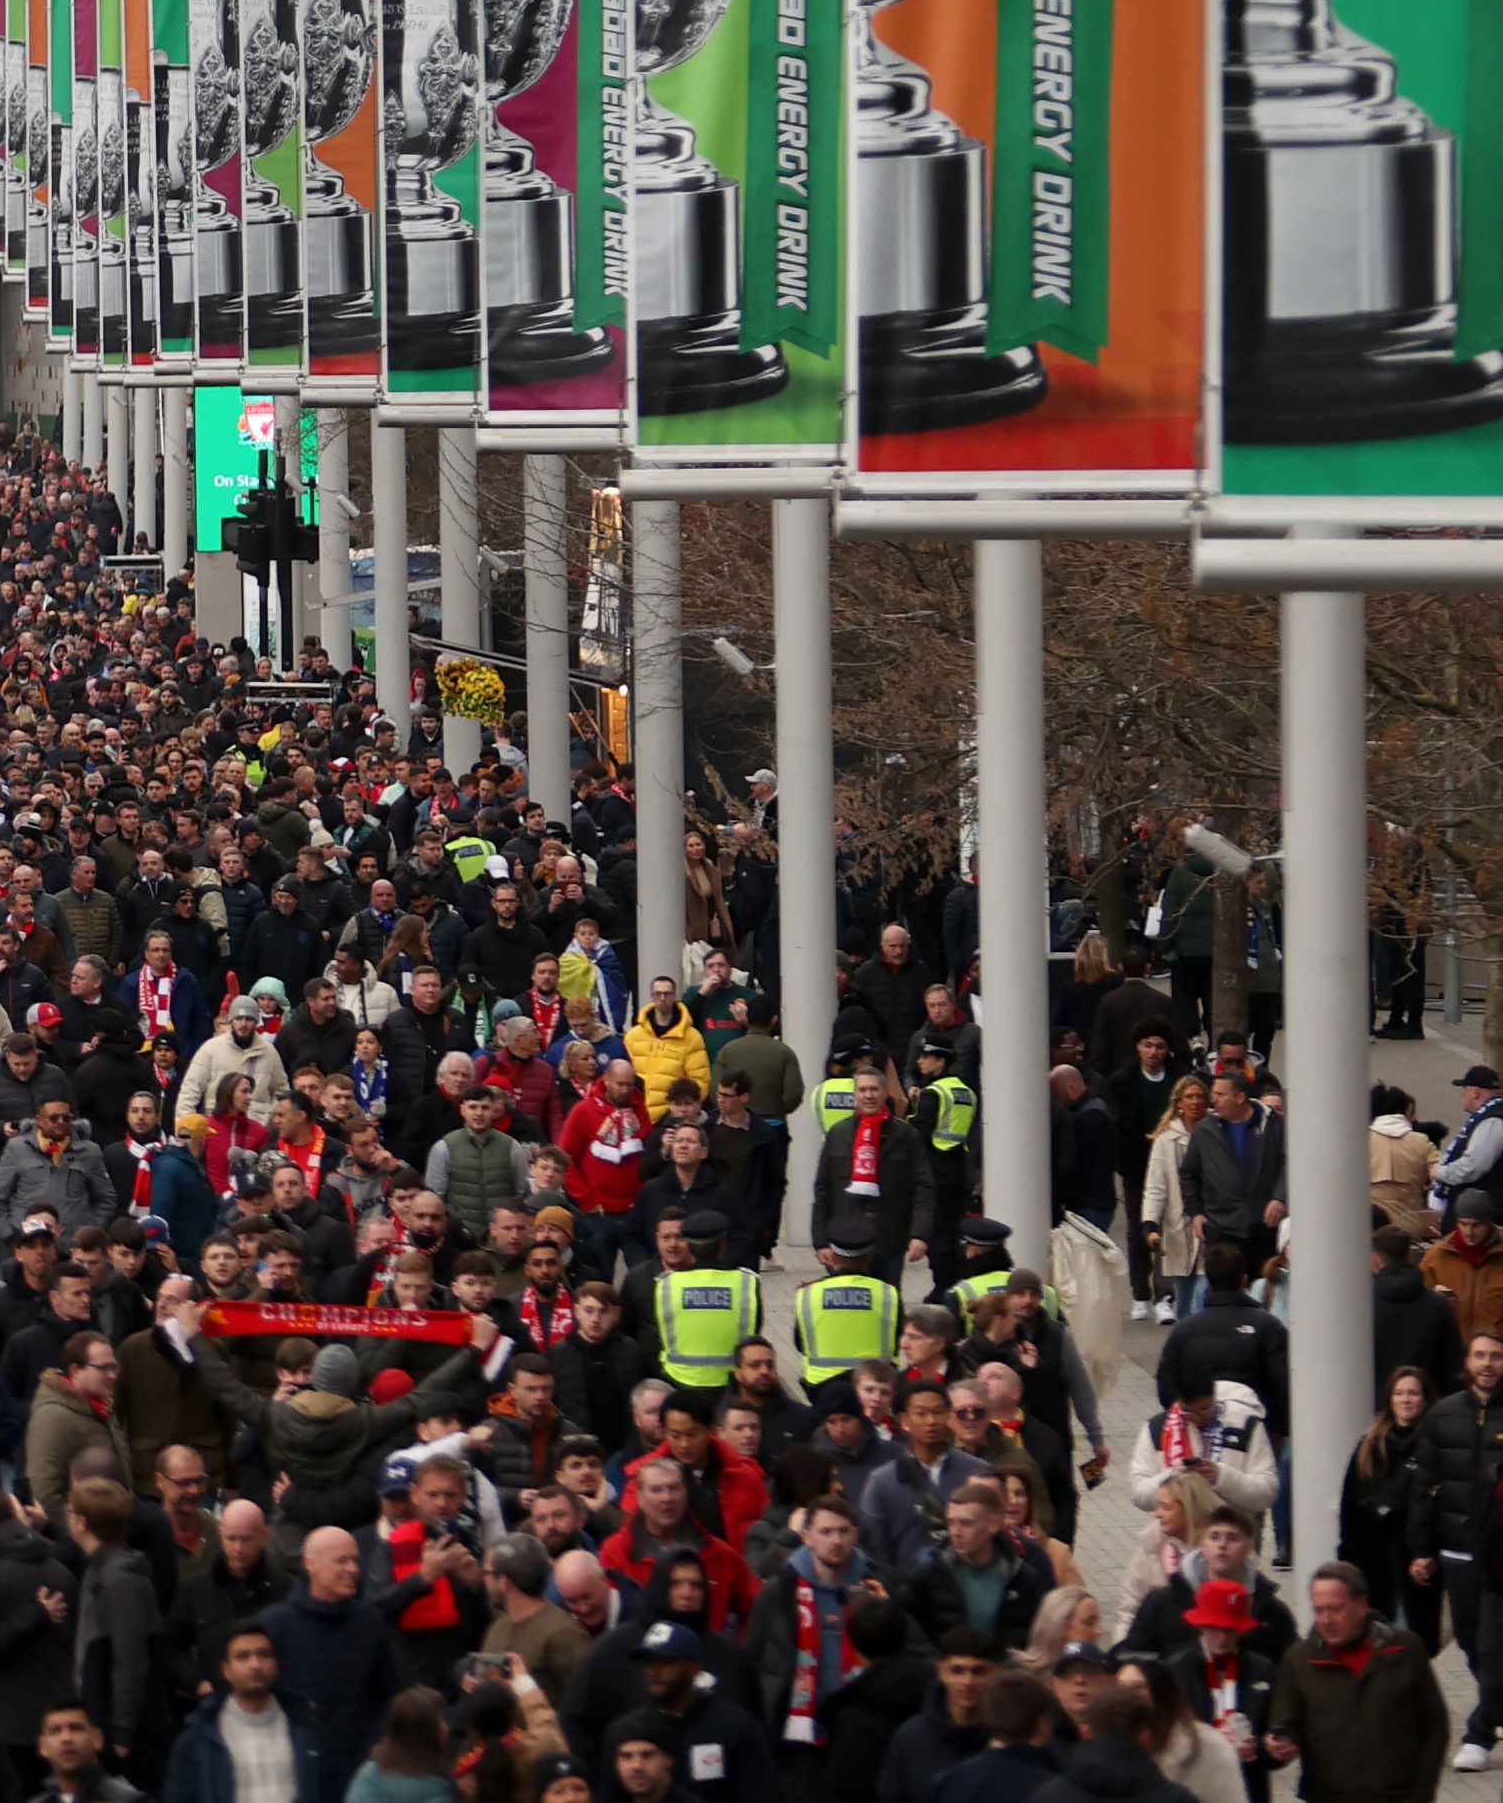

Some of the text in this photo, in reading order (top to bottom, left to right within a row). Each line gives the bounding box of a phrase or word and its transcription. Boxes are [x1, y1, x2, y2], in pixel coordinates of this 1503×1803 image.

[602, 86, 628, 204] ENERGY
[774, 55, 811, 201] ENERGY
[603, 209, 628, 298] DRINK
[774, 201, 810, 312] DRINK
[1031, 166, 1075, 306] DRINK
[214, 475, 235, 488] On
[684, 1288, 732, 1307] POLICE
[824, 1289, 872, 1307] POLICE
